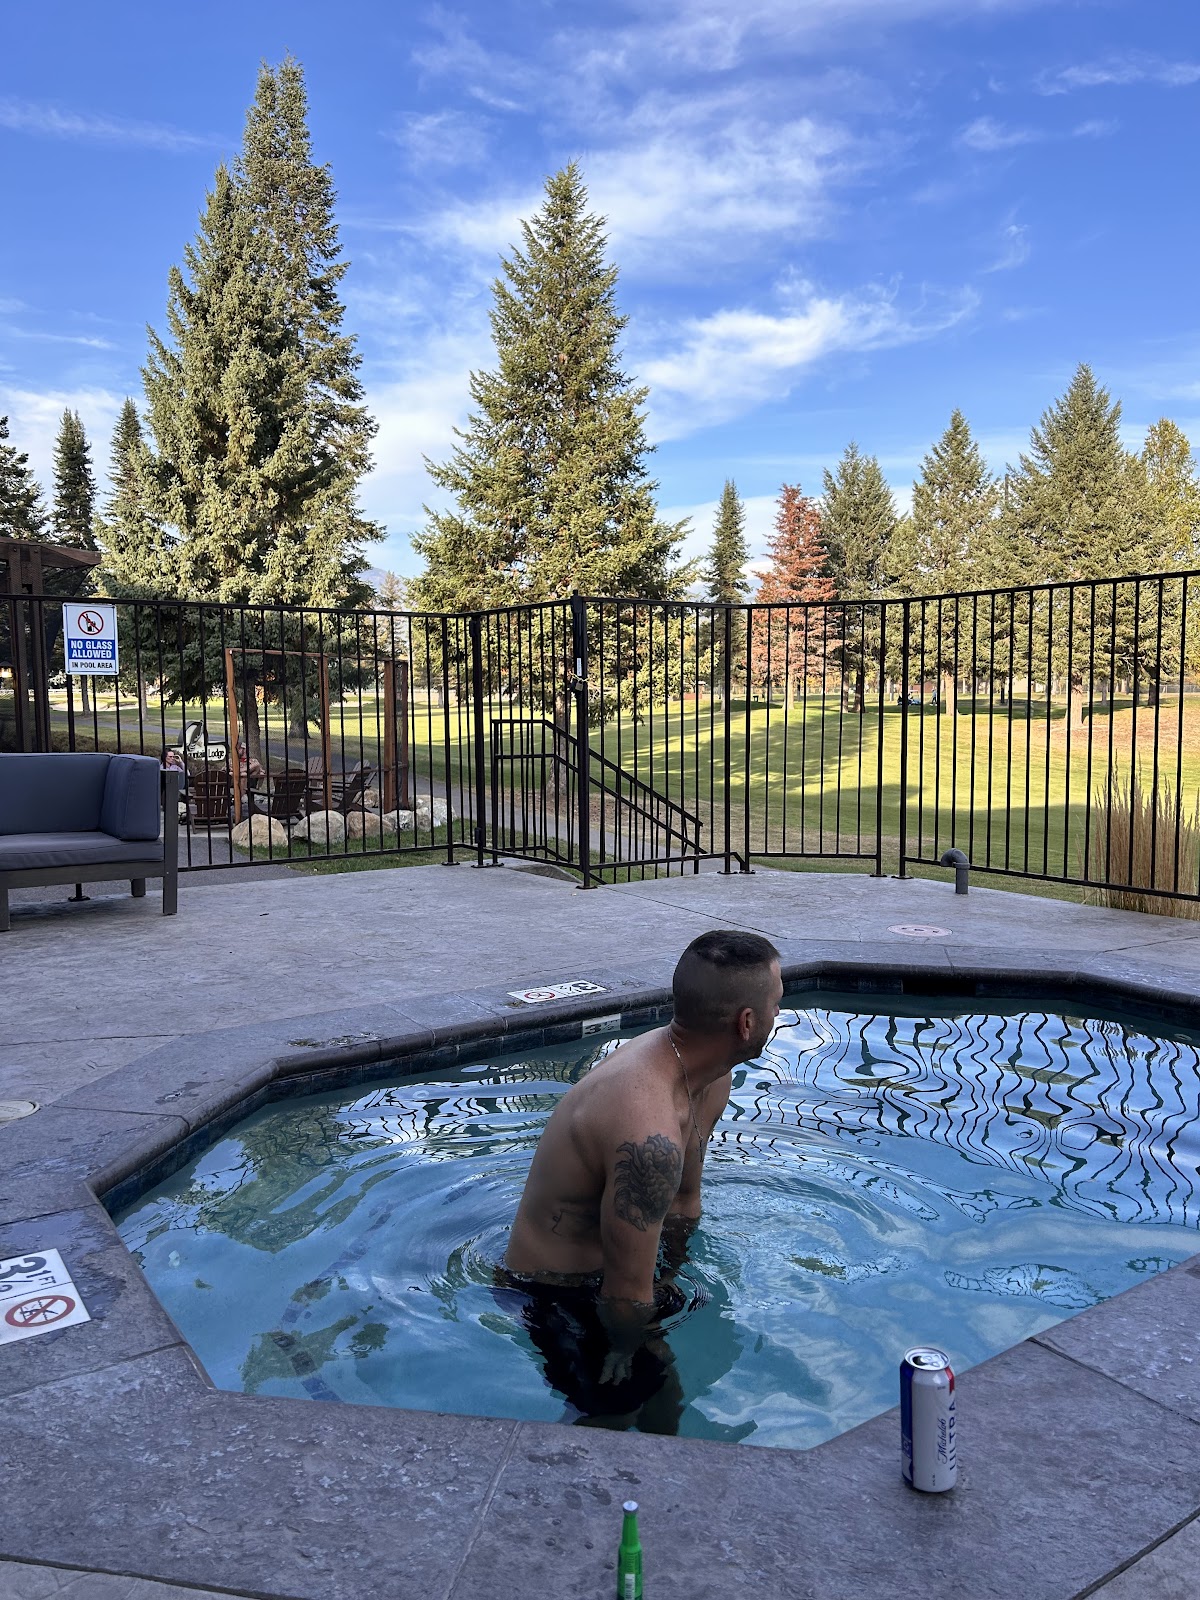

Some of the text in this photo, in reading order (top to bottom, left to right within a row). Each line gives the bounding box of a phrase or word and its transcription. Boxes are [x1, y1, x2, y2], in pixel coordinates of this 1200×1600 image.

[71, 640, 113, 650] NO GLASS
[72, 650, 112, 658] ALLOWED
[208, 748, 224, 759] Lodge
[937, 1418, 948, 1465] Michelob
